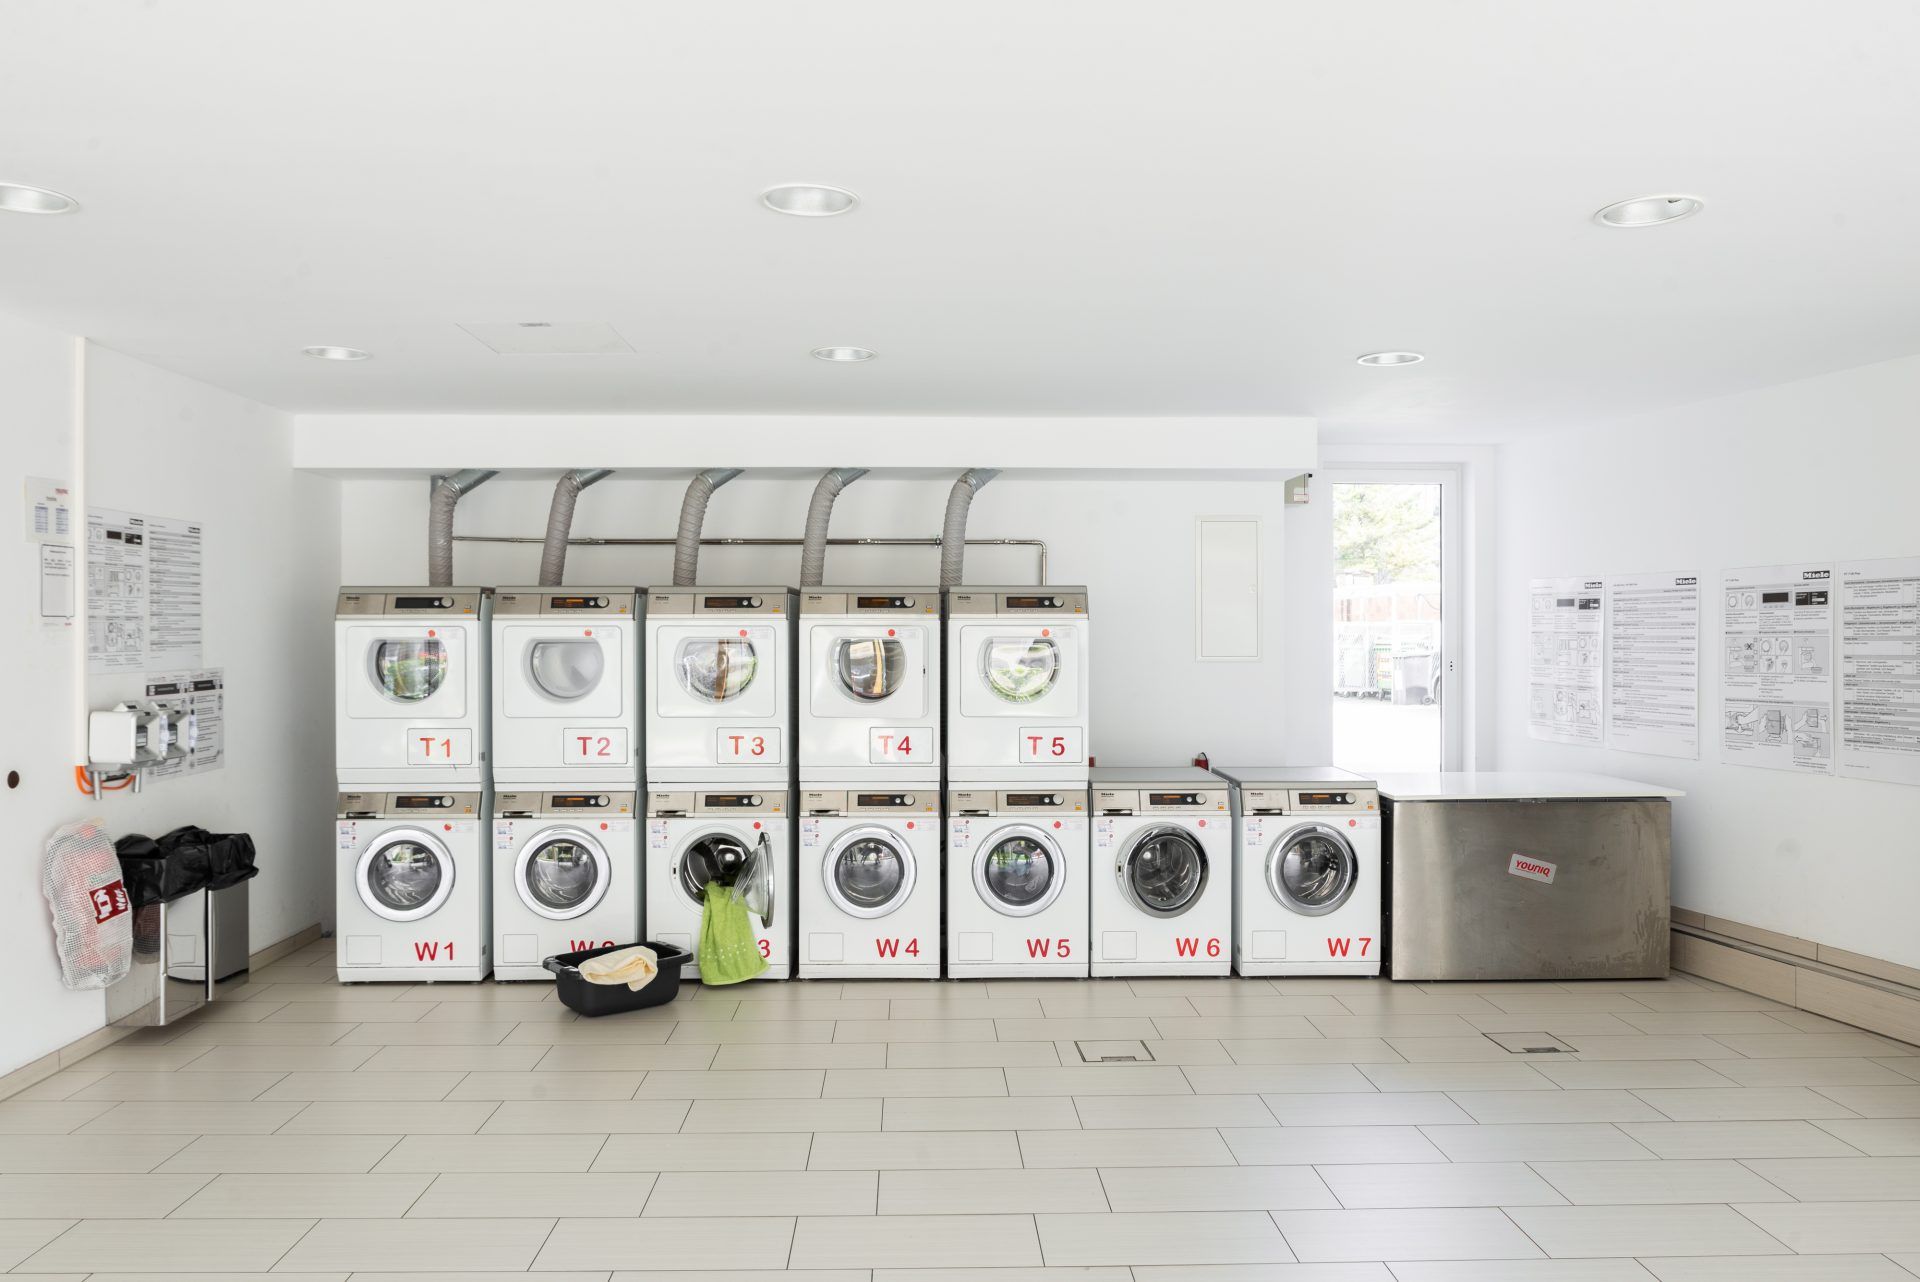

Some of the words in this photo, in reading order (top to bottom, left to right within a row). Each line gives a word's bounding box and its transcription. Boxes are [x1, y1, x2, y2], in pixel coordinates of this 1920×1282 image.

[1803, 571, 1830, 579] Miele
[420, 737, 451, 758] T1
[414, 941, 455, 961] W1
